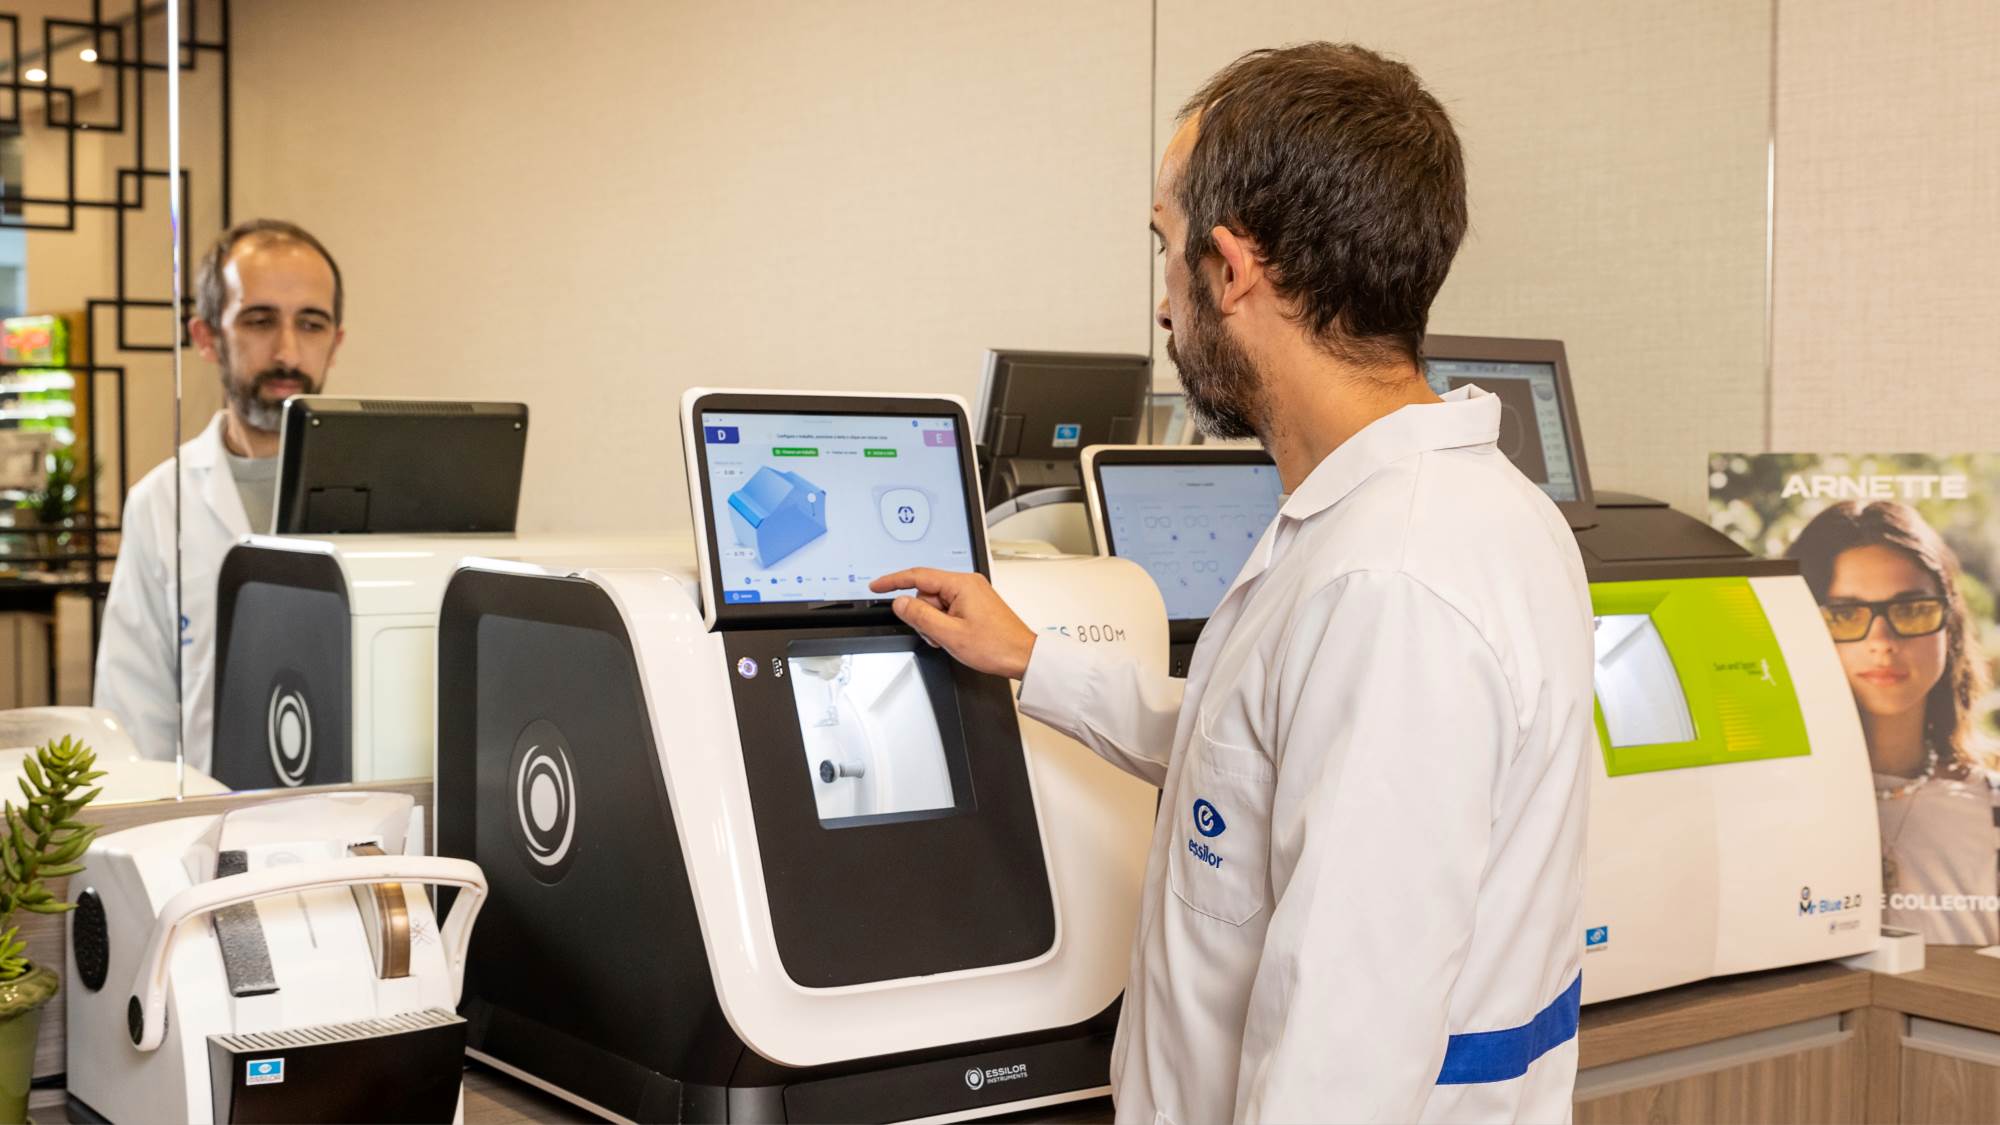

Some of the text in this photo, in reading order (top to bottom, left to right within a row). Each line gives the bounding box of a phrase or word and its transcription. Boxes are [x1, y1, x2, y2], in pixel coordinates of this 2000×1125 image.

[717, 429, 727, 441] D
[936, 433, 944, 444] E
[1781, 475, 1968, 498] ARNETTE
[1189, 838, 1223, 868] essilor
[1889, 893, 2000, 911] COLLECTIO
[985, 1064, 1026, 1078] ESSILOR
[987, 1072, 1028, 1084] INSTRUMENTS
